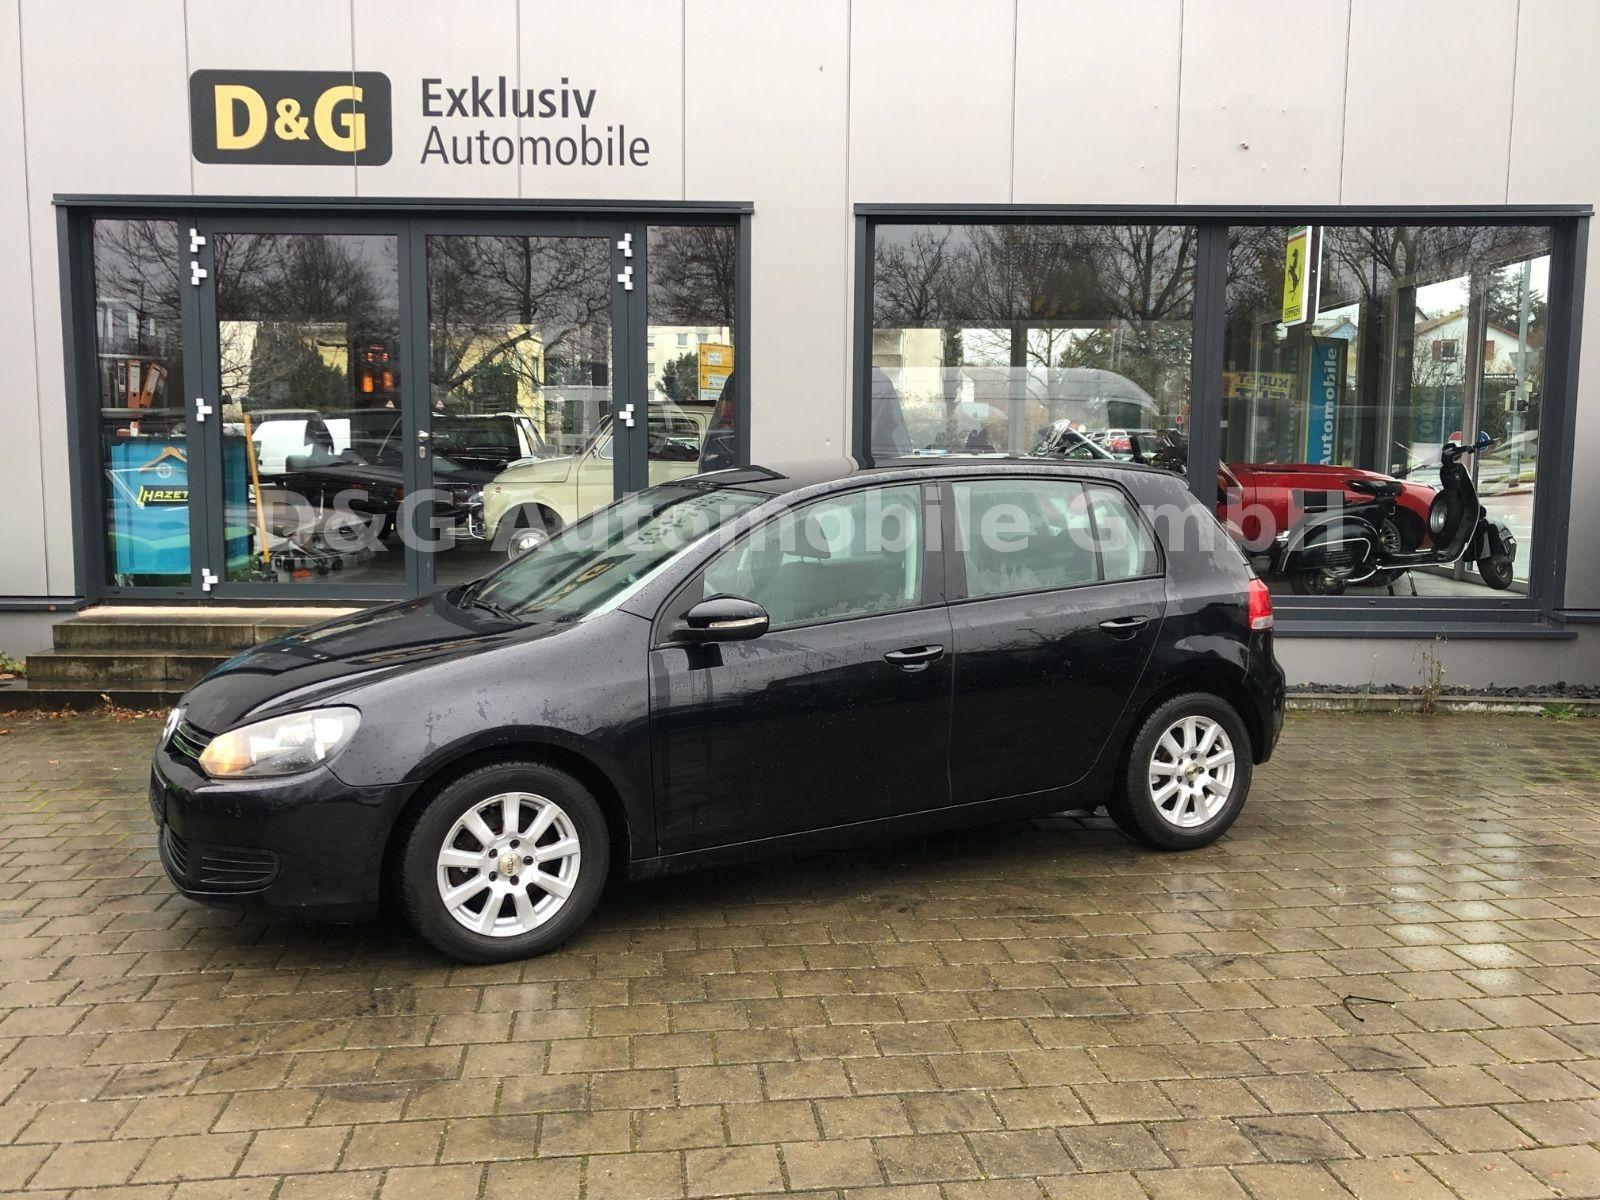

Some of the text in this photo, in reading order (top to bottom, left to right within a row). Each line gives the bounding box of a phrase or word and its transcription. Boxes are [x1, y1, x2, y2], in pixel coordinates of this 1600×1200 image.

[214, 84, 367, 152] D&G
[421, 76, 597, 119] Exklusiv
[420, 124, 650, 167] Automobile
[1320, 347, 1337, 466] Automobile
